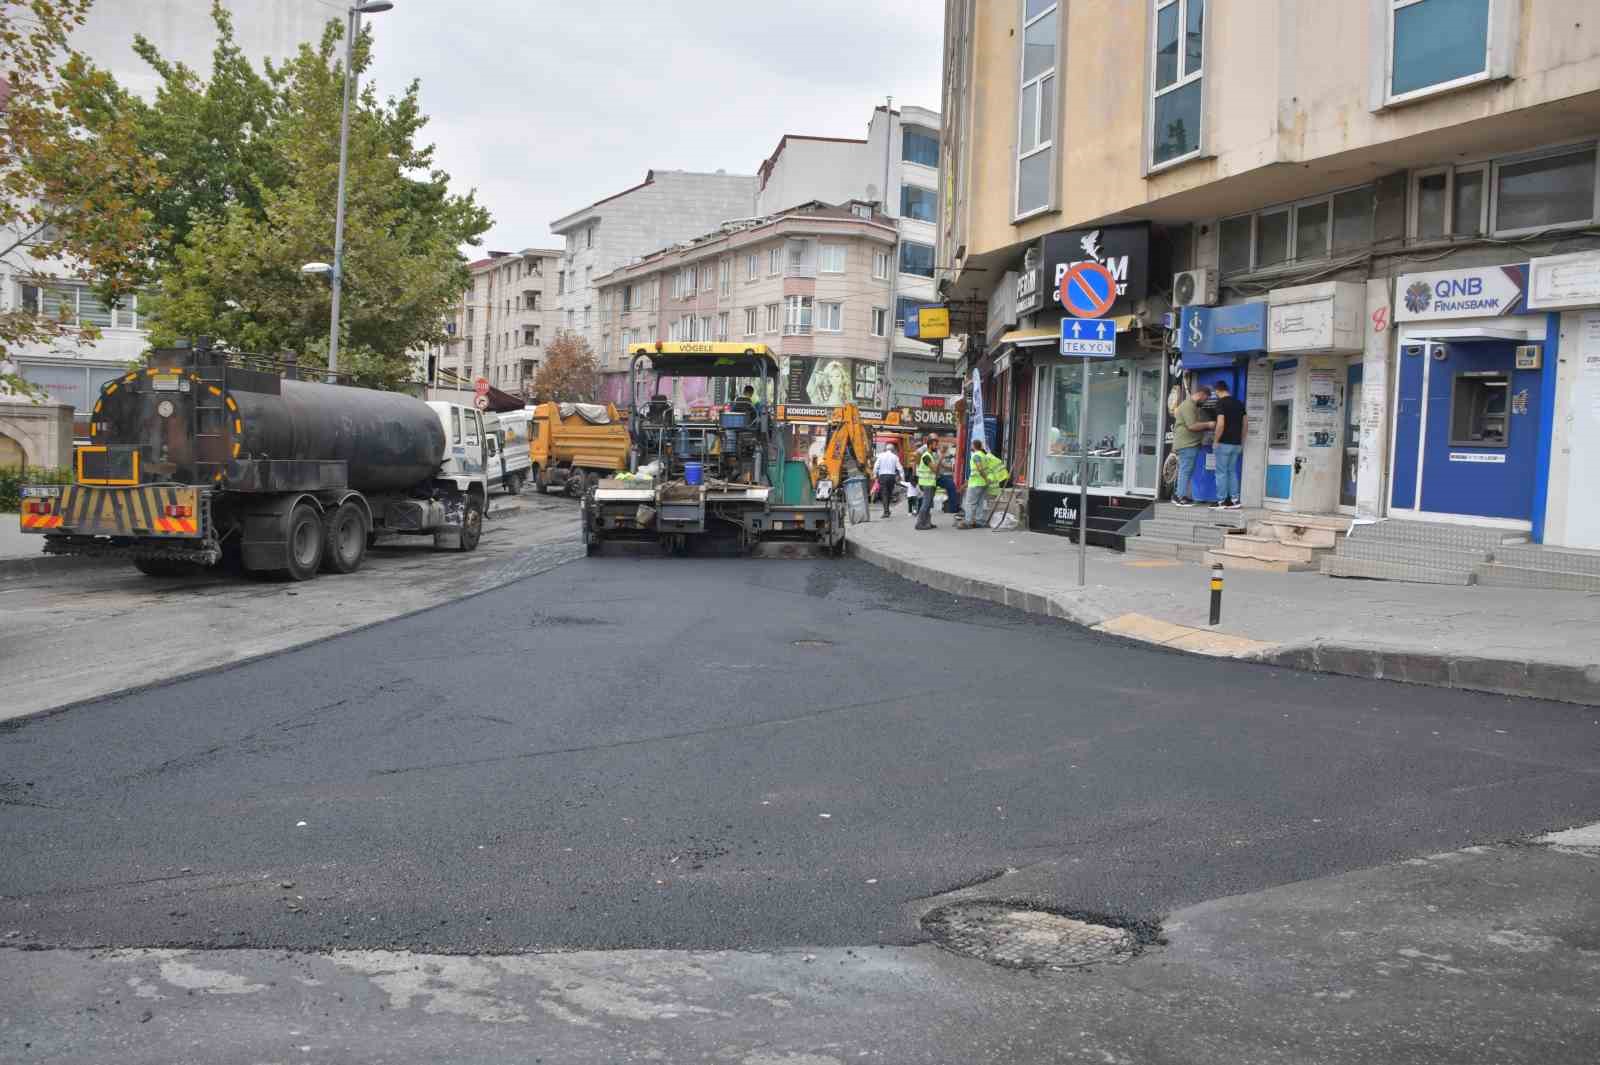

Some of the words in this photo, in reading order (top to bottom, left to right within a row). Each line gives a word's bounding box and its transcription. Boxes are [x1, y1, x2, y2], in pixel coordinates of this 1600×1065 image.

[1435, 277, 1483, 299] QNB
[1065, 343, 1086, 351] TEK
[914, 410, 953, 424] SOMAR
